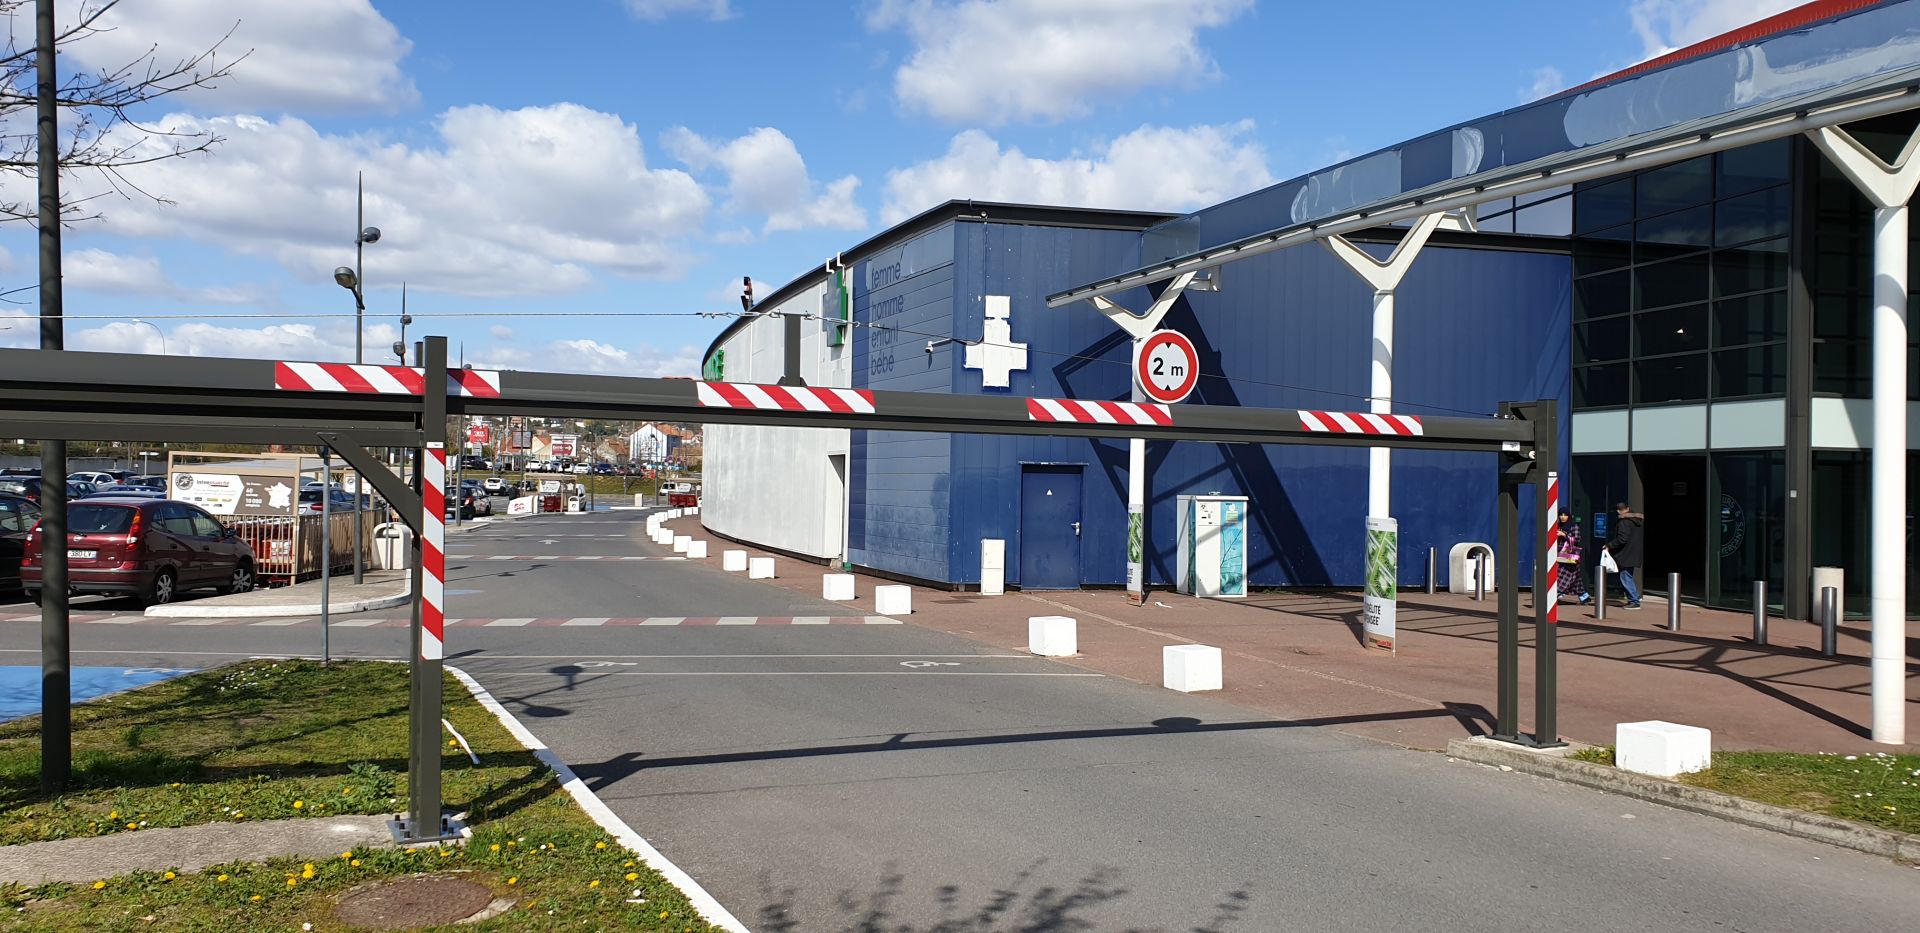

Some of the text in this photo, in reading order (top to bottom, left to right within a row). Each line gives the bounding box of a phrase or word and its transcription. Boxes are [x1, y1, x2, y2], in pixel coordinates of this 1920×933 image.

[871, 261, 901, 290] femme
[871, 294, 904, 322] homme
[871, 320, 899, 348] enfant
[870, 350, 895, 376] bébé
[1153, 357, 1183, 377] 2 m
